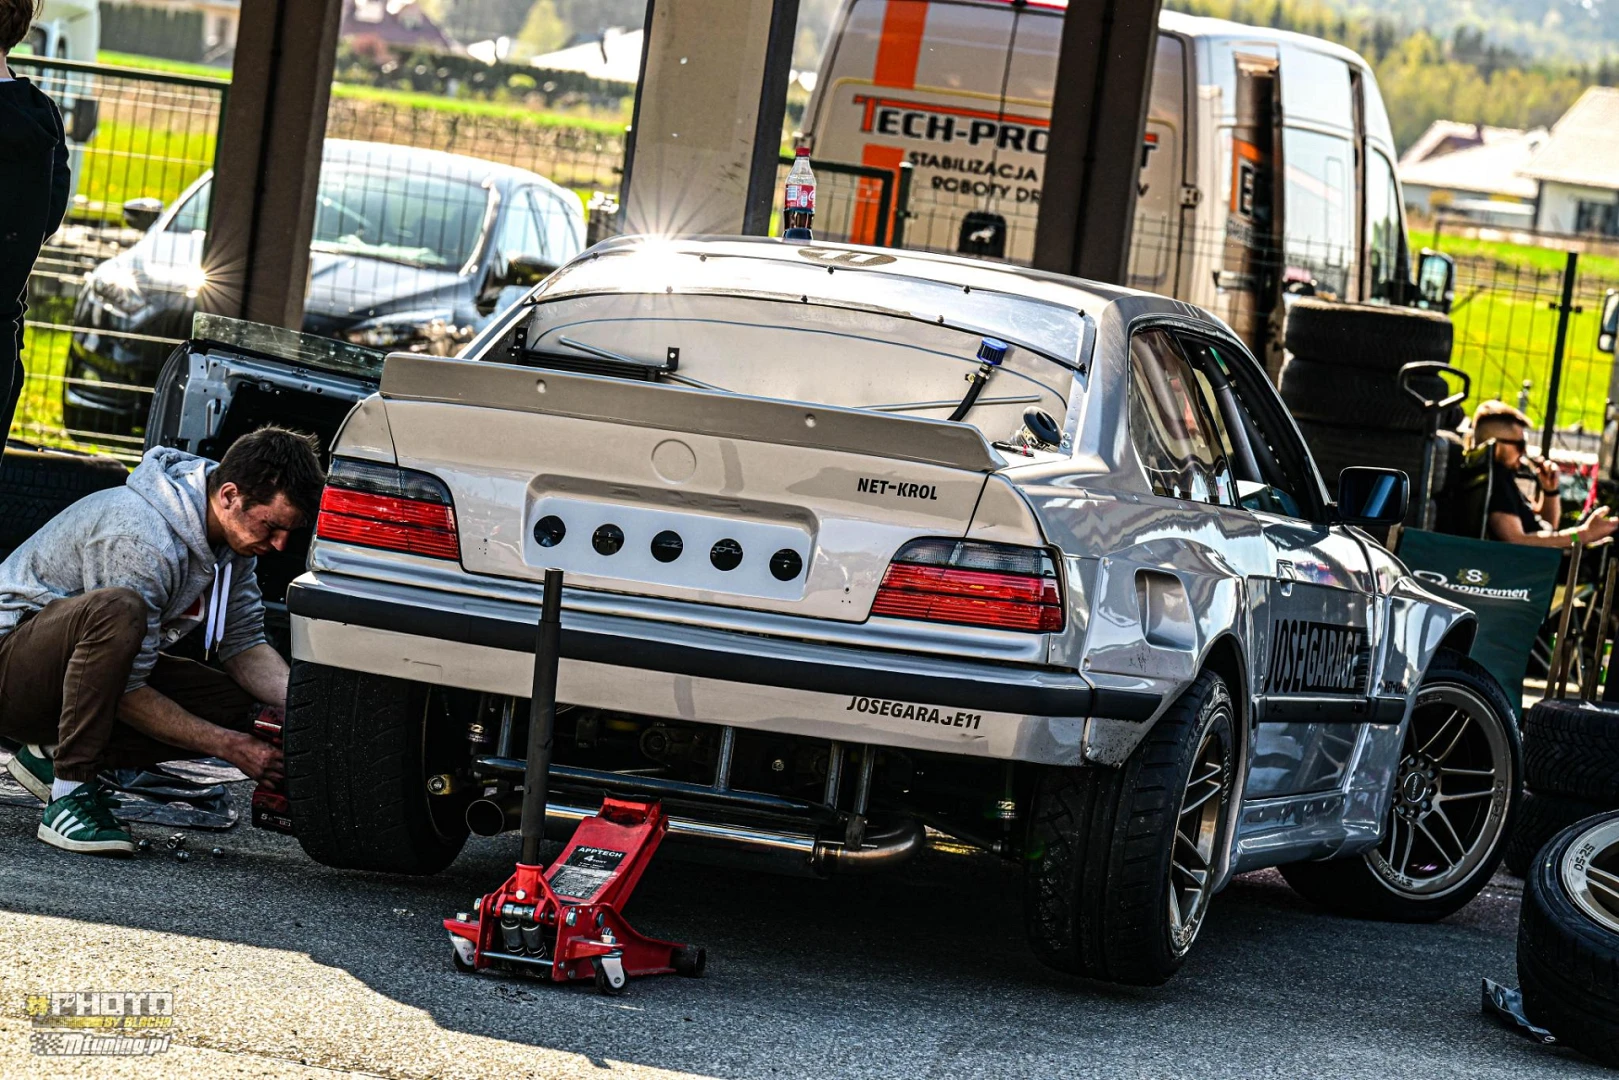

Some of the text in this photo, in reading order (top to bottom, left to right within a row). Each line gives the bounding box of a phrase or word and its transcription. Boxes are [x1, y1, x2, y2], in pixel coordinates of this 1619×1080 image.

[909, 151, 1039, 182] STABILIZACJA
[932, 175, 1012, 202] ROBOTY
[857, 477, 938, 501] NET-KROL
[578, 847, 623, 858] APPTECH
